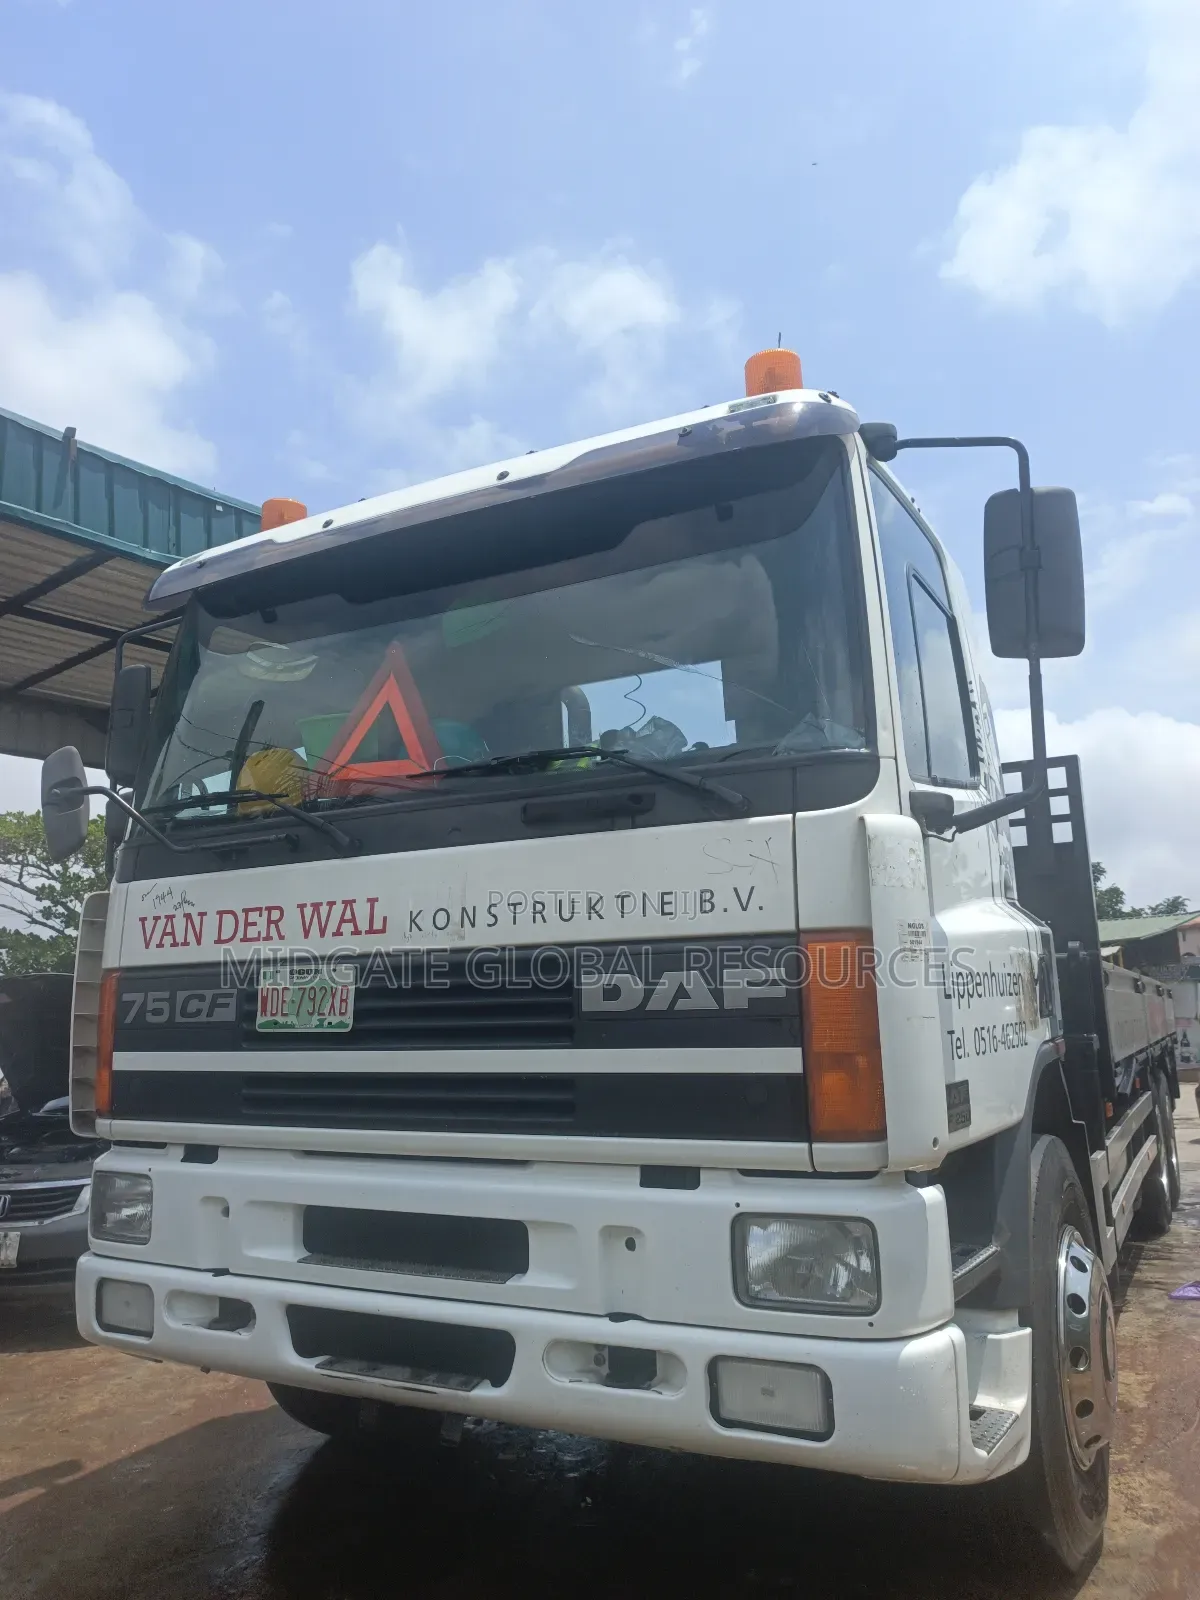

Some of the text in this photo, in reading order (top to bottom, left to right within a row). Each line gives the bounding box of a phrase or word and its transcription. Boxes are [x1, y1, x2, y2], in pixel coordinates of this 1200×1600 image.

[138, 912, 208, 950] VAN
[213, 905, 285, 945] DER
[296, 897, 388, 940] WAL
[408, 891, 674, 933] KONSTRUKTIE
[581, 968, 787, 1012] DAF
[941, 960, 1024, 1010] Lippenhuizen
[946, 1027, 970, 1060] Tel.
